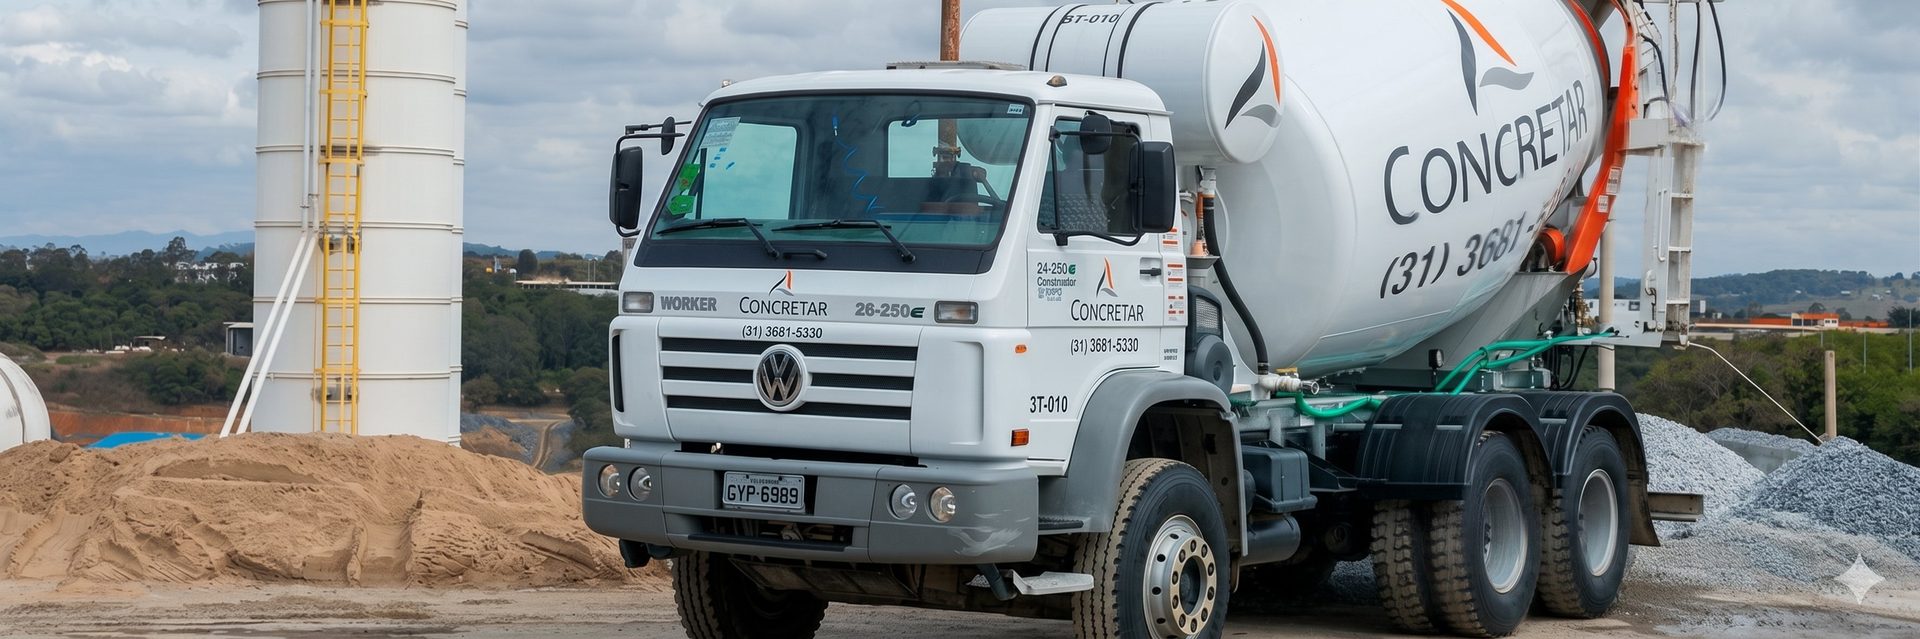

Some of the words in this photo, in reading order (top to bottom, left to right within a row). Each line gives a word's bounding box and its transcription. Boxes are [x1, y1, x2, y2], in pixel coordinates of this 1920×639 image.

[1384, 79, 1588, 226] CONCRETAR
[1380, 242, 1450, 299] (31)
[660, 295, 717, 312] WORKER
[739, 296, 827, 317] CONCRETAR
[1070, 299, 1144, 322] CONCRETAR
[741, 325, 762, 339] (31)
[765, 325, 823, 339] 3681-5330
[1070, 339, 1088, 356] (31)
[1089, 337, 1139, 353] 3681-5330
[1029, 395, 1068, 413] 3T-010
